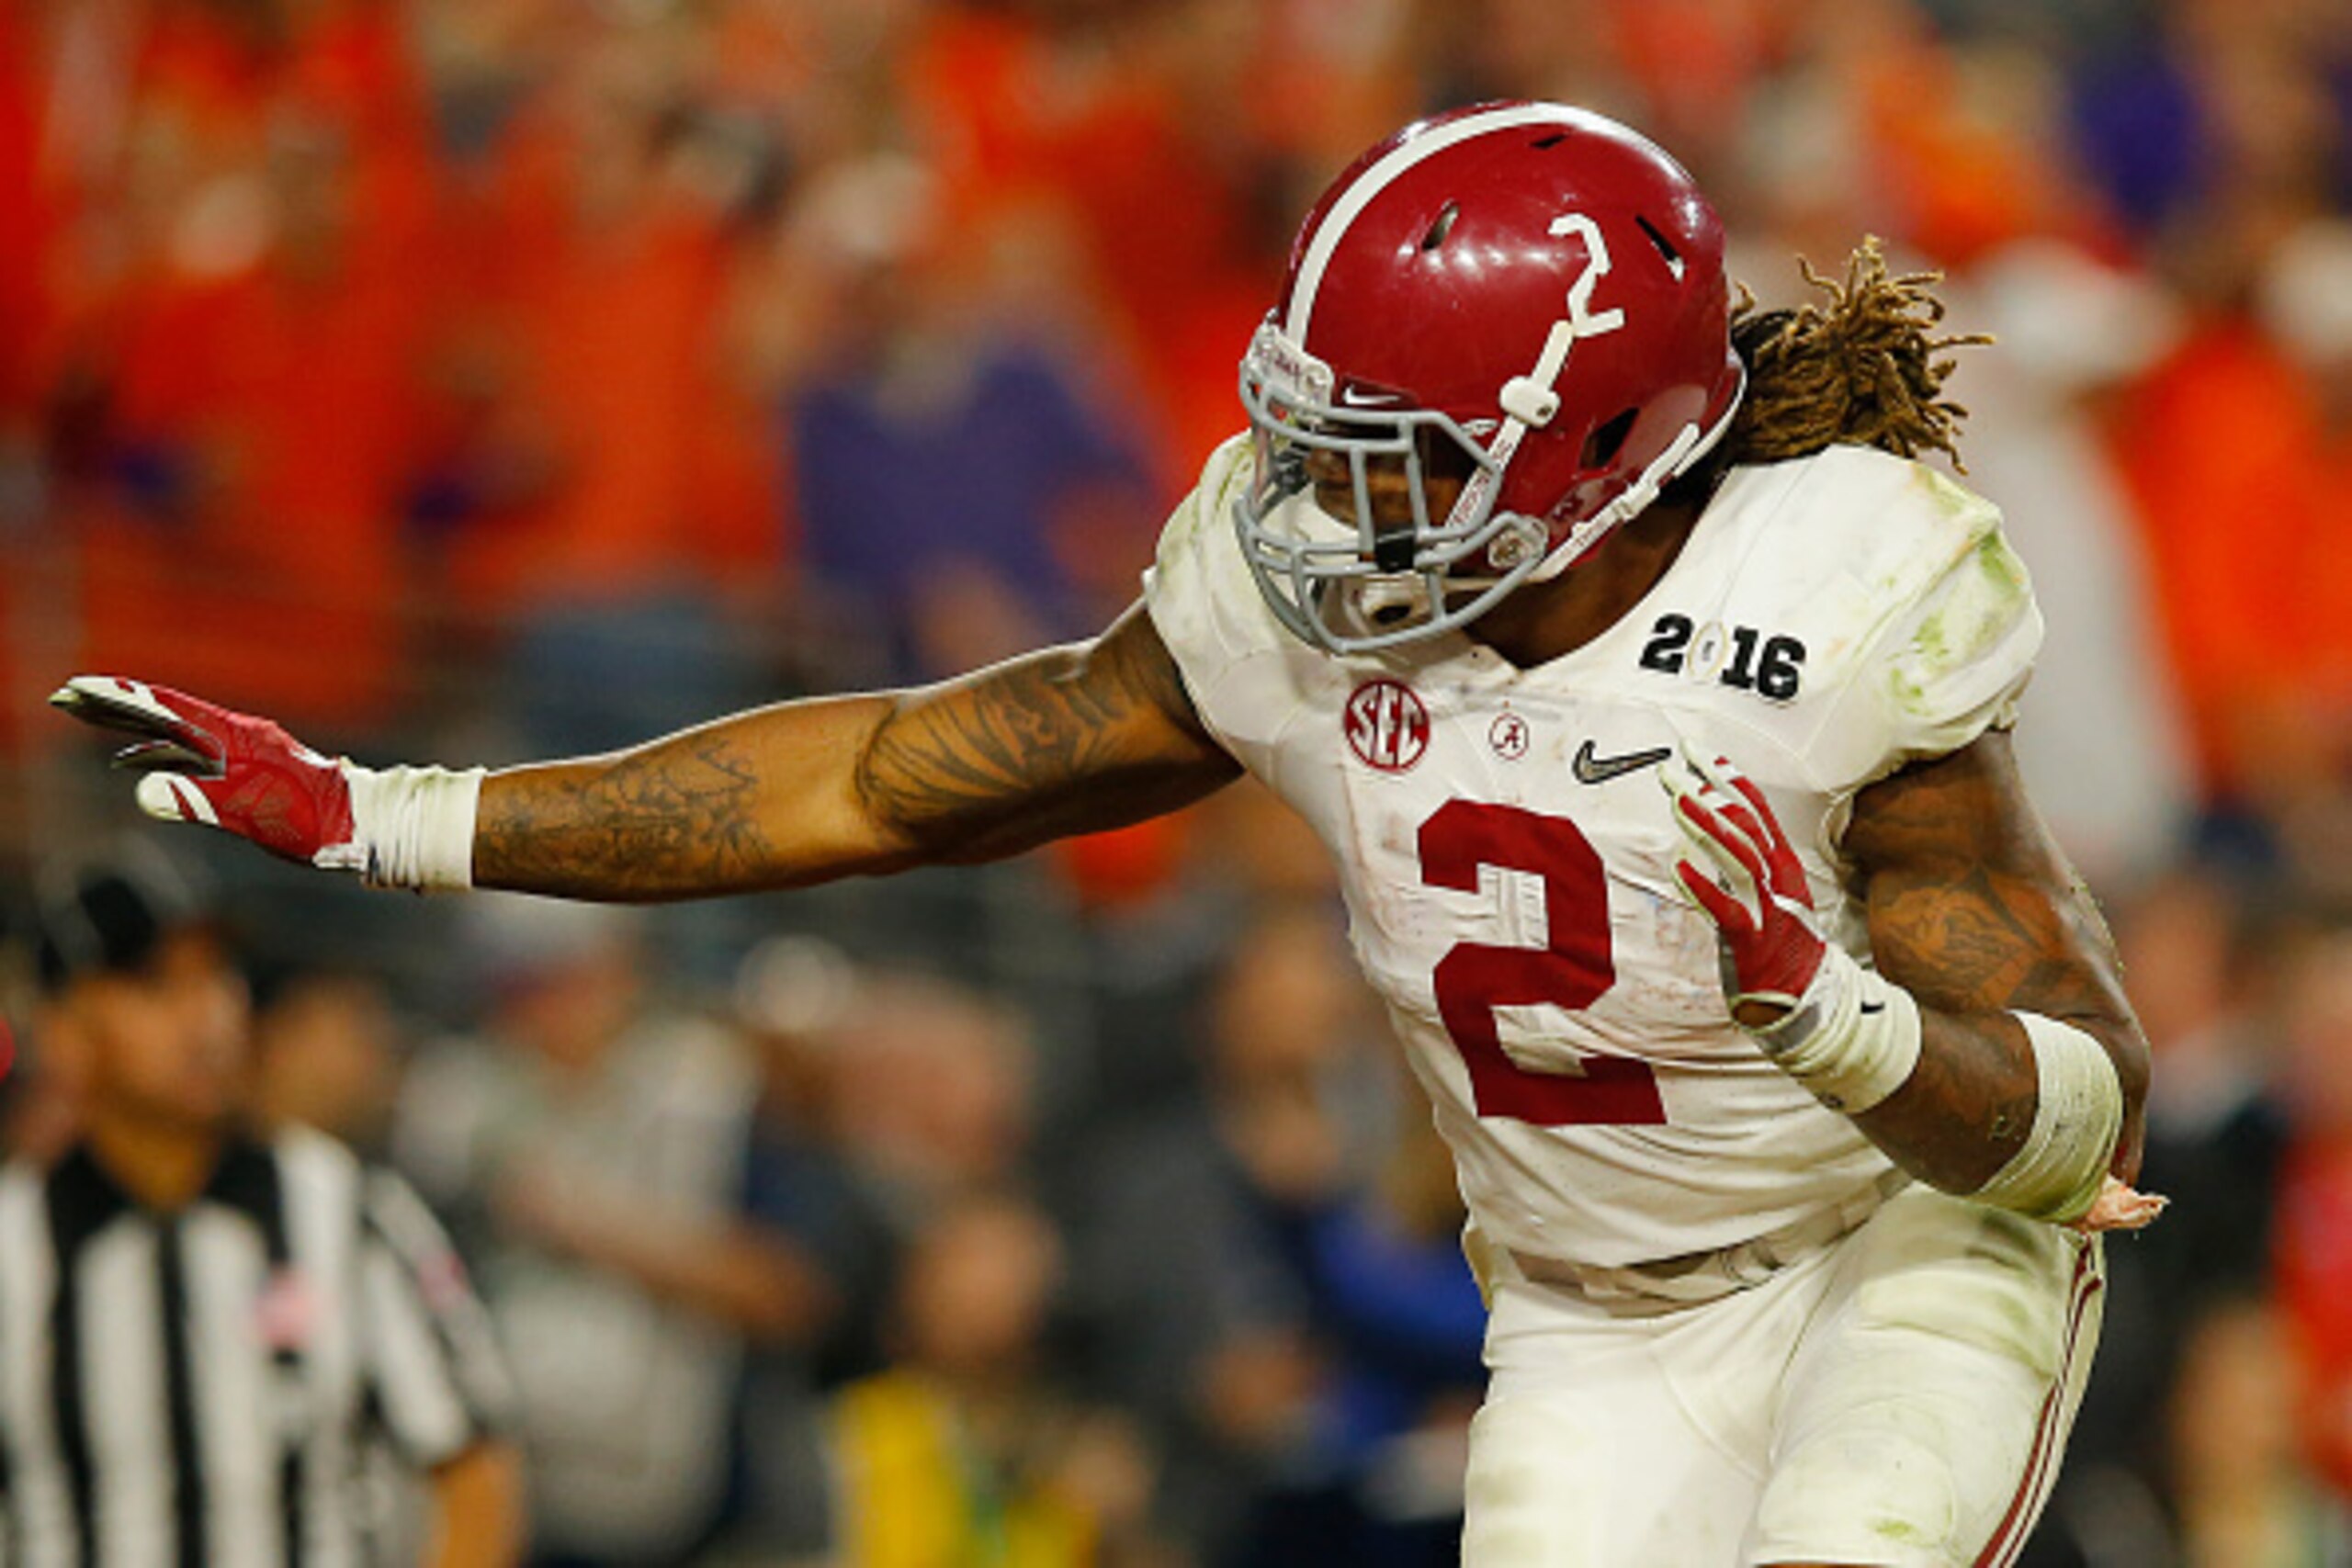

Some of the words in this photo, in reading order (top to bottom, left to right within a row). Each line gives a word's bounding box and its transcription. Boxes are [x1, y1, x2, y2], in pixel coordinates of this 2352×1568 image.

[1547, 212, 1625, 337] 2
[1639, 613, 1806, 701] 2016
[1347, 682, 1429, 771] SEC
[1418, 797, 1668, 1126] 2
